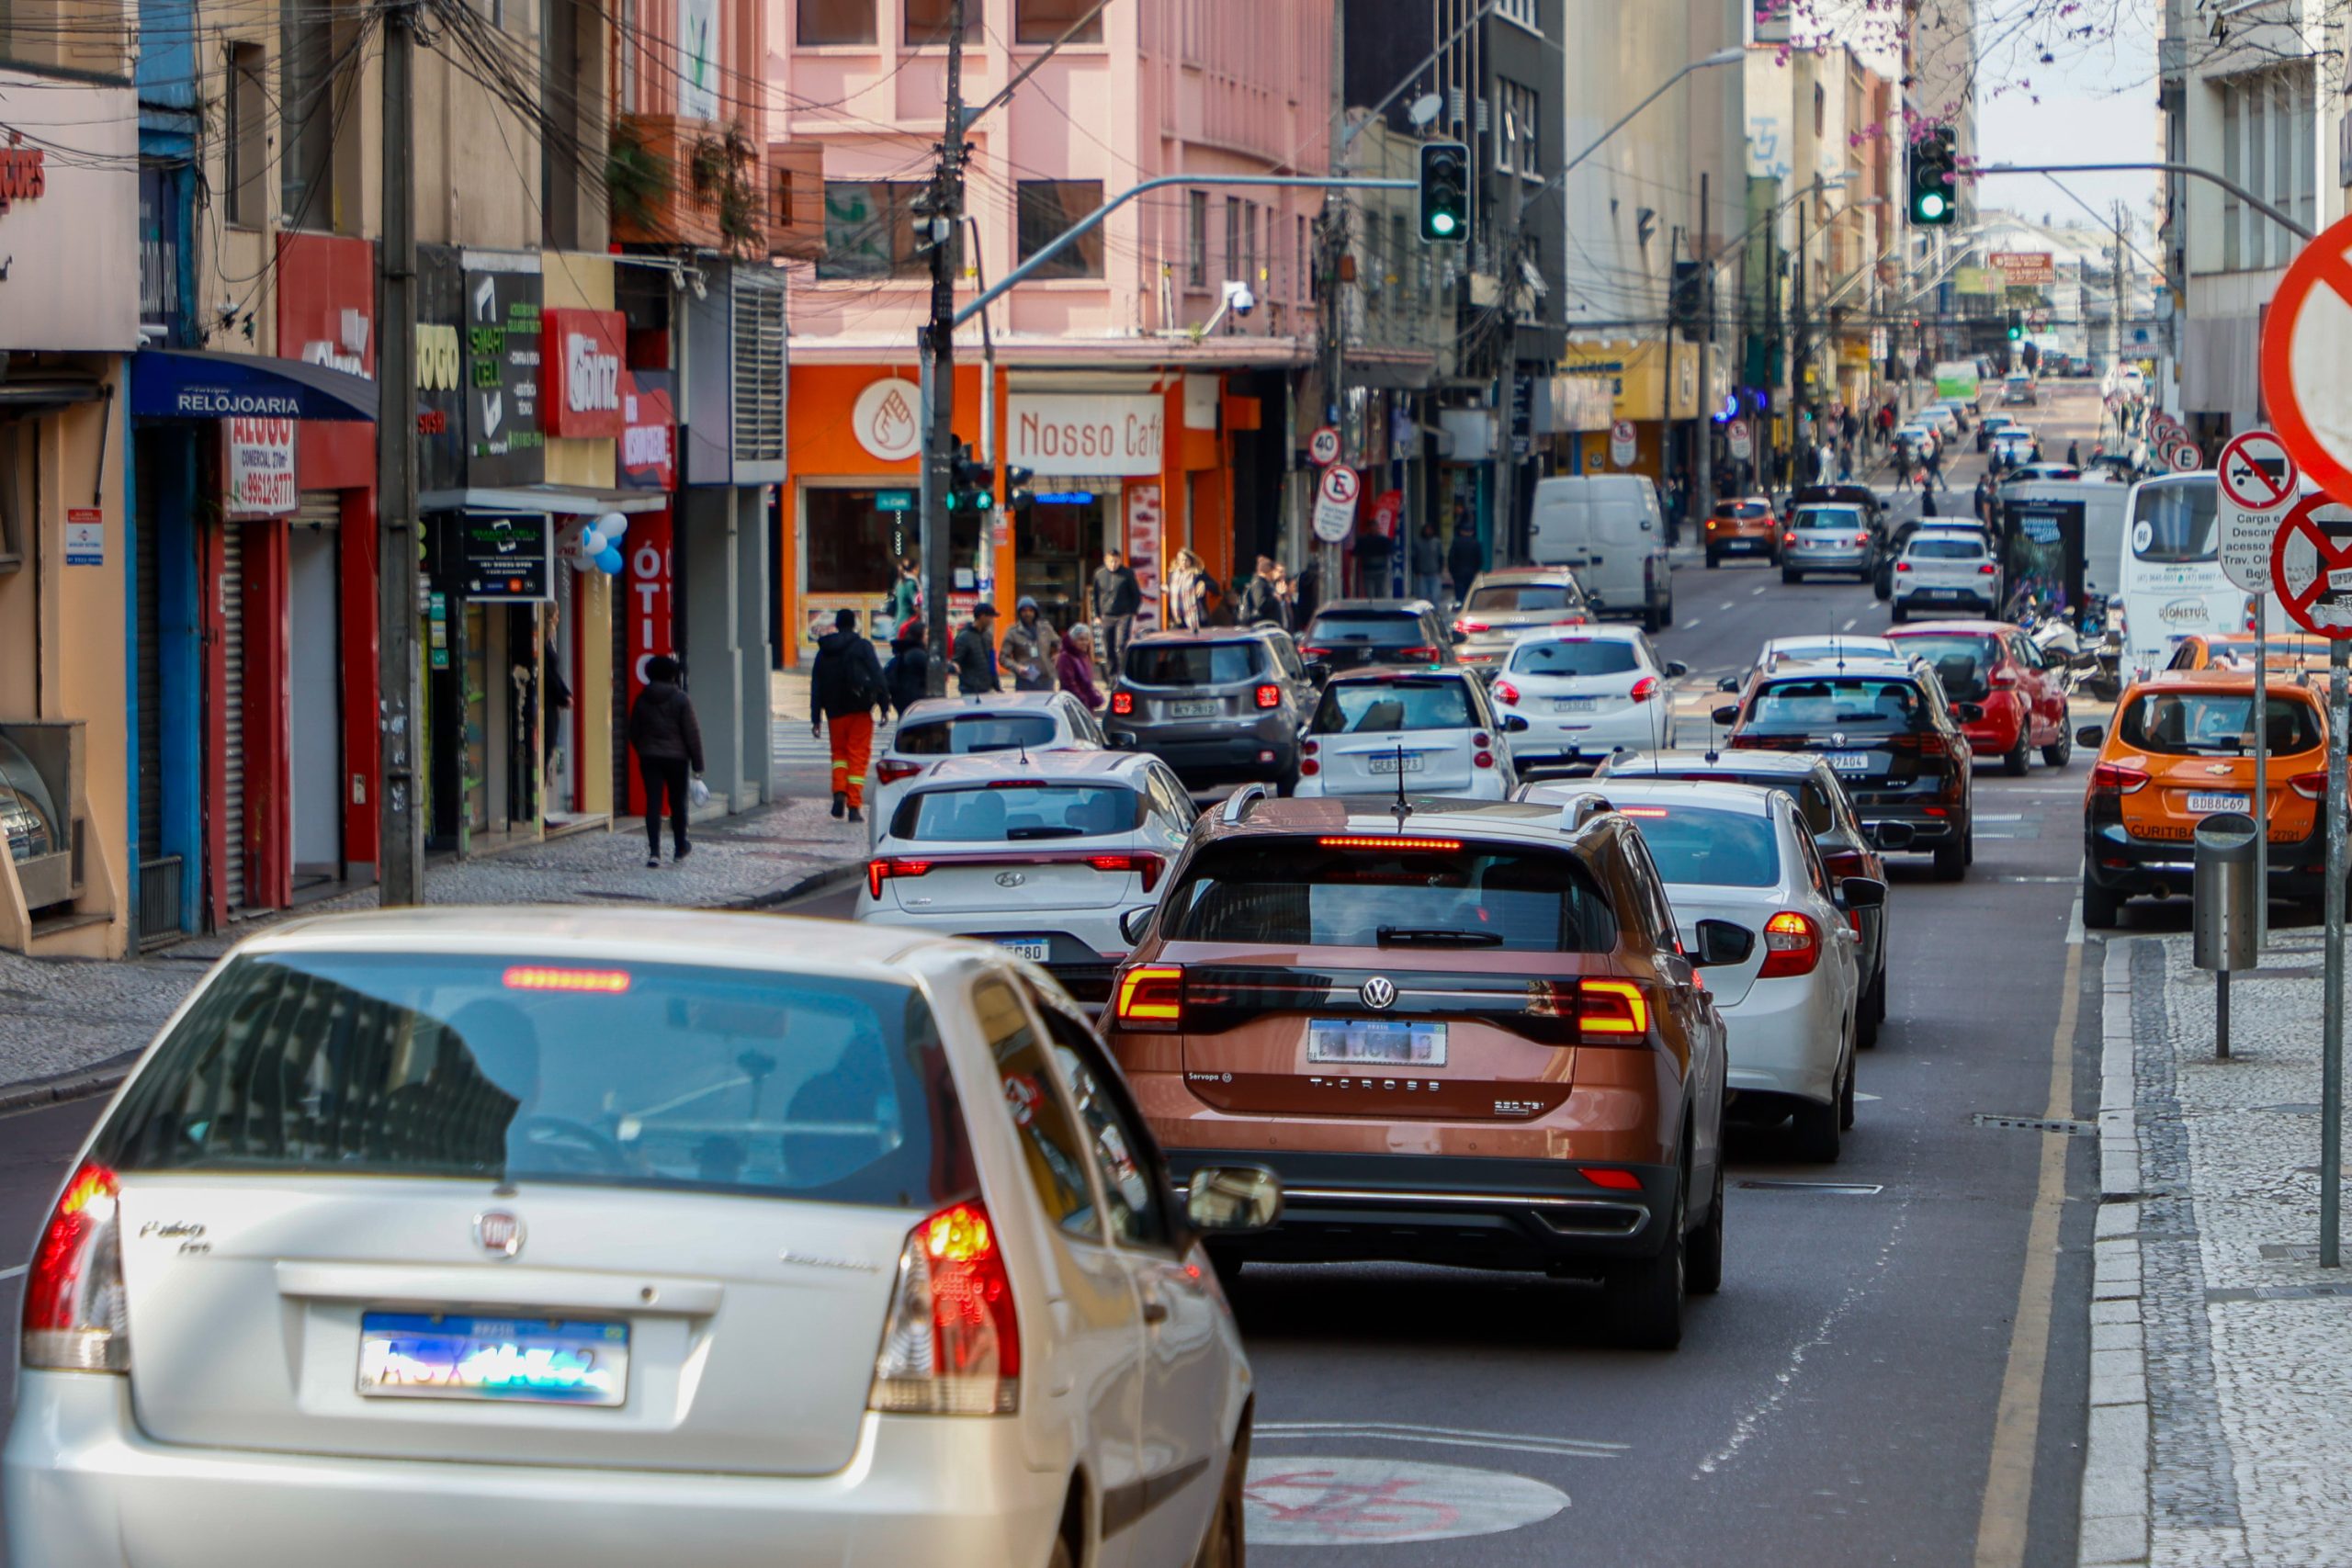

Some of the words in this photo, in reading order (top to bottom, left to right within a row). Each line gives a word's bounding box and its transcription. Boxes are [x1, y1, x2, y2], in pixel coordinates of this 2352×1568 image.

[470, 327, 505, 356] SMART
[475, 360, 503, 388] CELL
[178, 394, 300, 413] RELOJOARIA
[233, 418, 291, 446] ALUGO
[418, 412, 446, 434] SUSHI
[1020, 412, 1114, 457] Nosso
[1315, 435, 1334, 451] 40
[2181, 448, 2193, 467] E
[2237, 513, 2270, 525] Carga
[2273, 515, 2280, 524] e
[2226, 543, 2266, 551] acesso
[2223, 555, 2249, 565] Trav.
[1189, 1072, 1219, 1082] Servopa
[1310, 1077, 1440, 1091] T-CROSS
